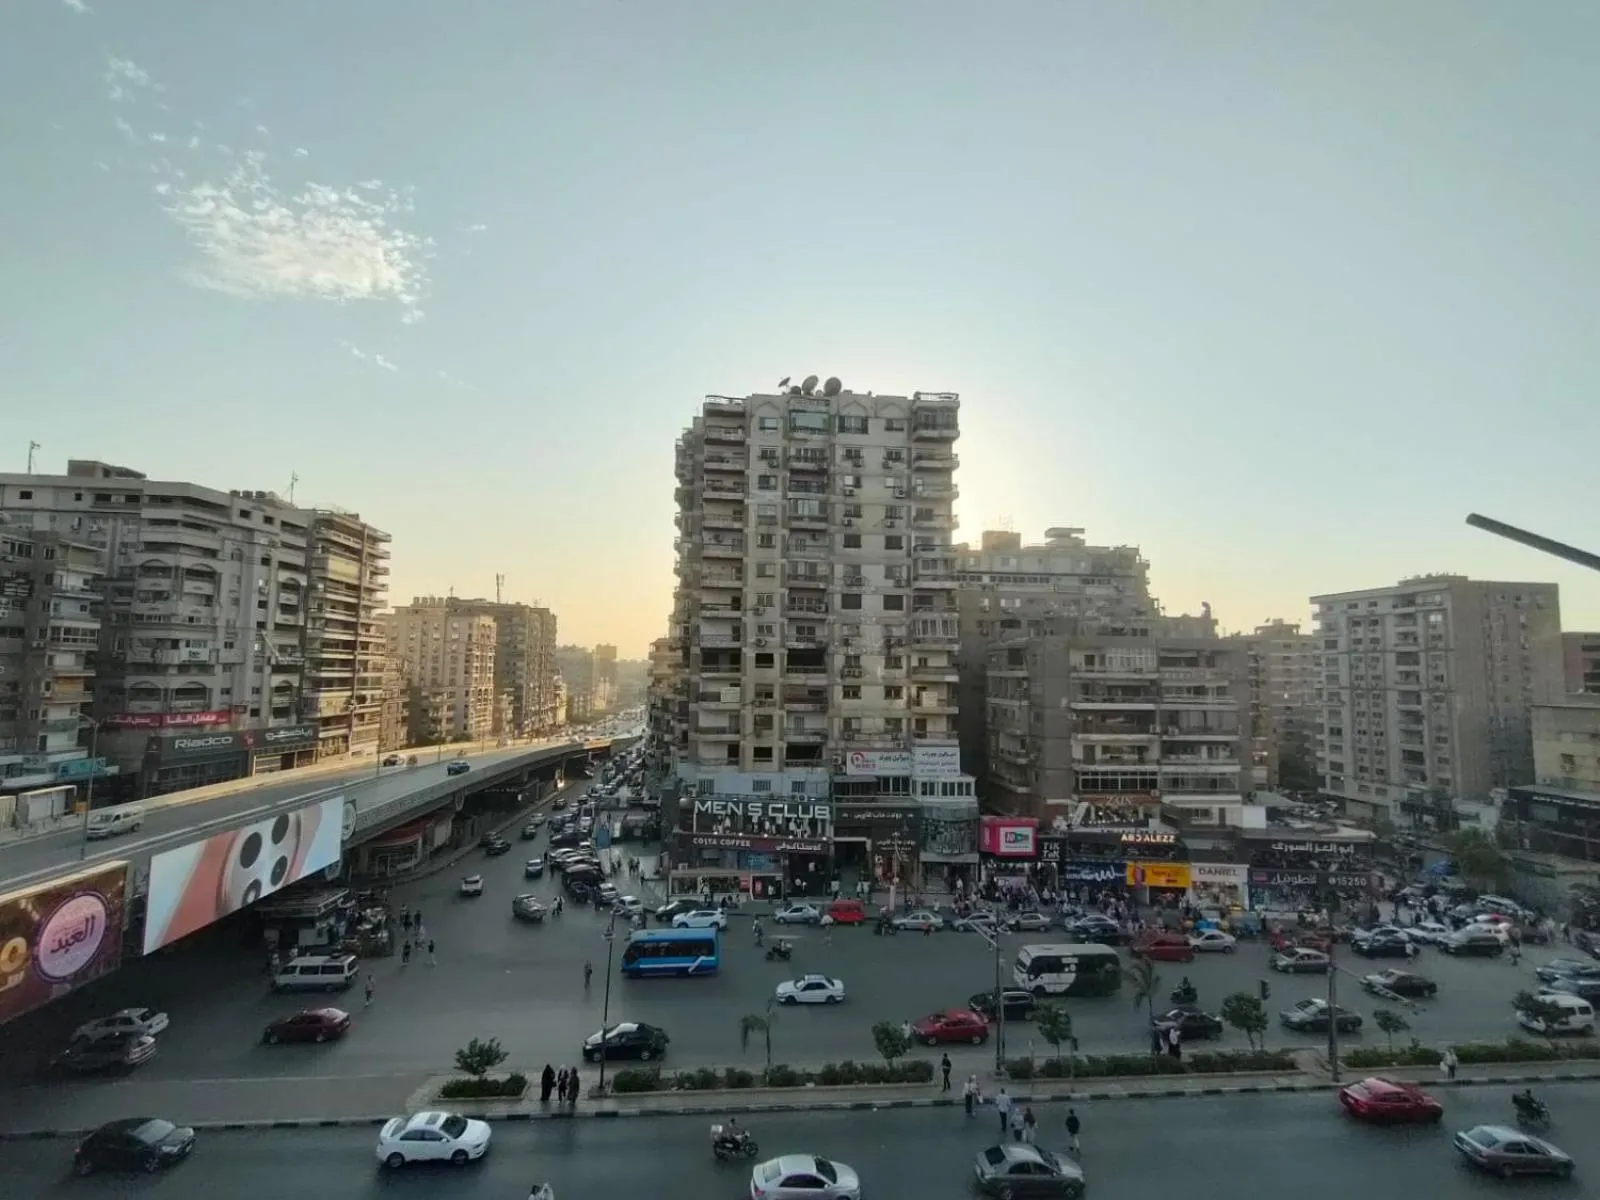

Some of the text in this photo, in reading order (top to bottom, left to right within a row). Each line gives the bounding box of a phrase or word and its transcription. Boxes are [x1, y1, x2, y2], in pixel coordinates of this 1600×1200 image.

[174, 736, 234, 750] Riadco
[768, 803, 830, 819] CLUB
[692, 837, 752, 847] COSTA COFFEE
